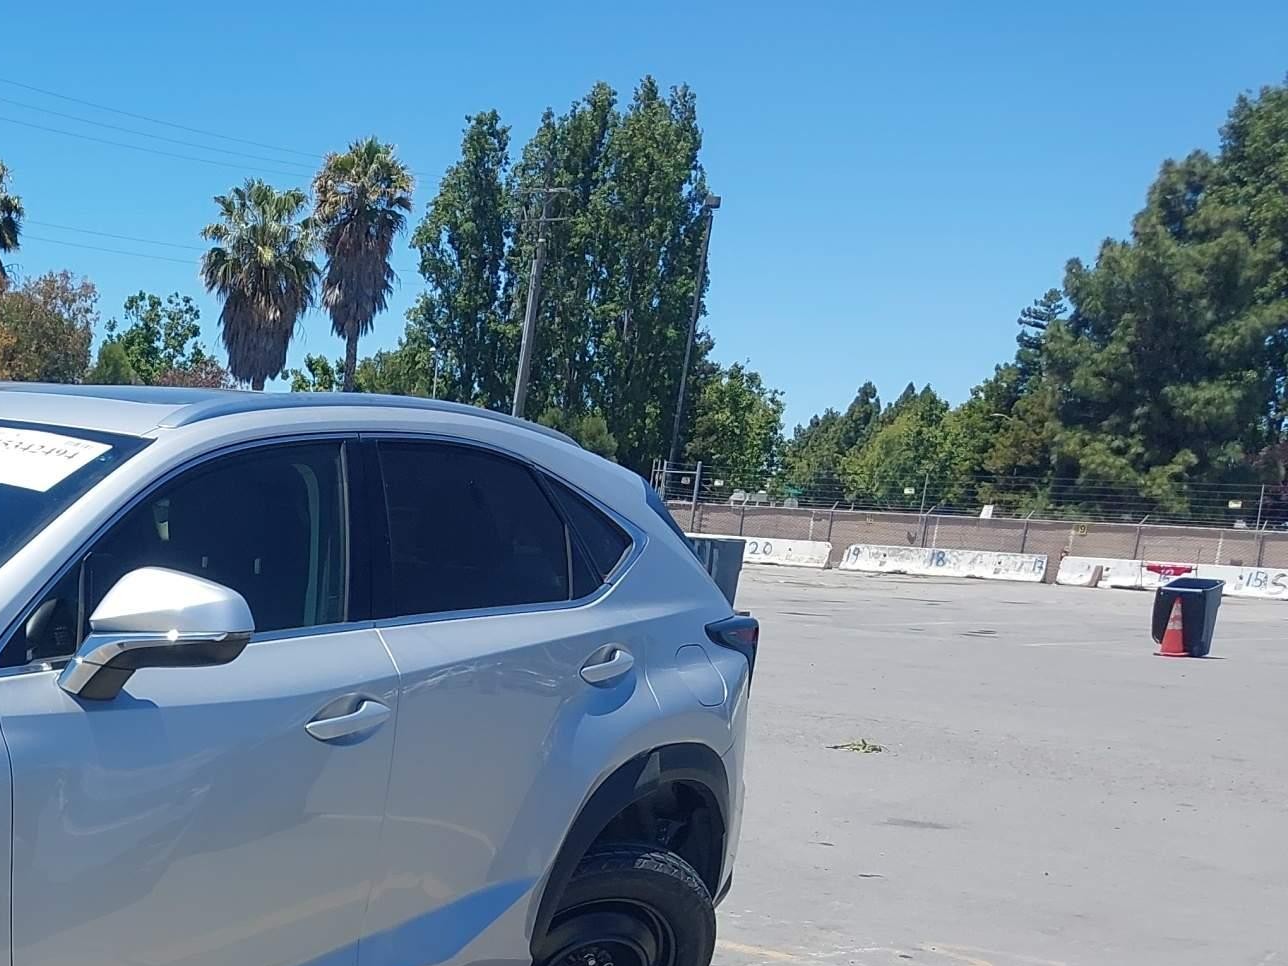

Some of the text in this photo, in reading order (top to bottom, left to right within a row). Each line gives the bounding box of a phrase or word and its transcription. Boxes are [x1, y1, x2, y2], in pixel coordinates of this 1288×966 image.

[748, 541, 773, 556] 20
[845, 546, 861, 565] 19
[929, 549, 947, 567] 18
